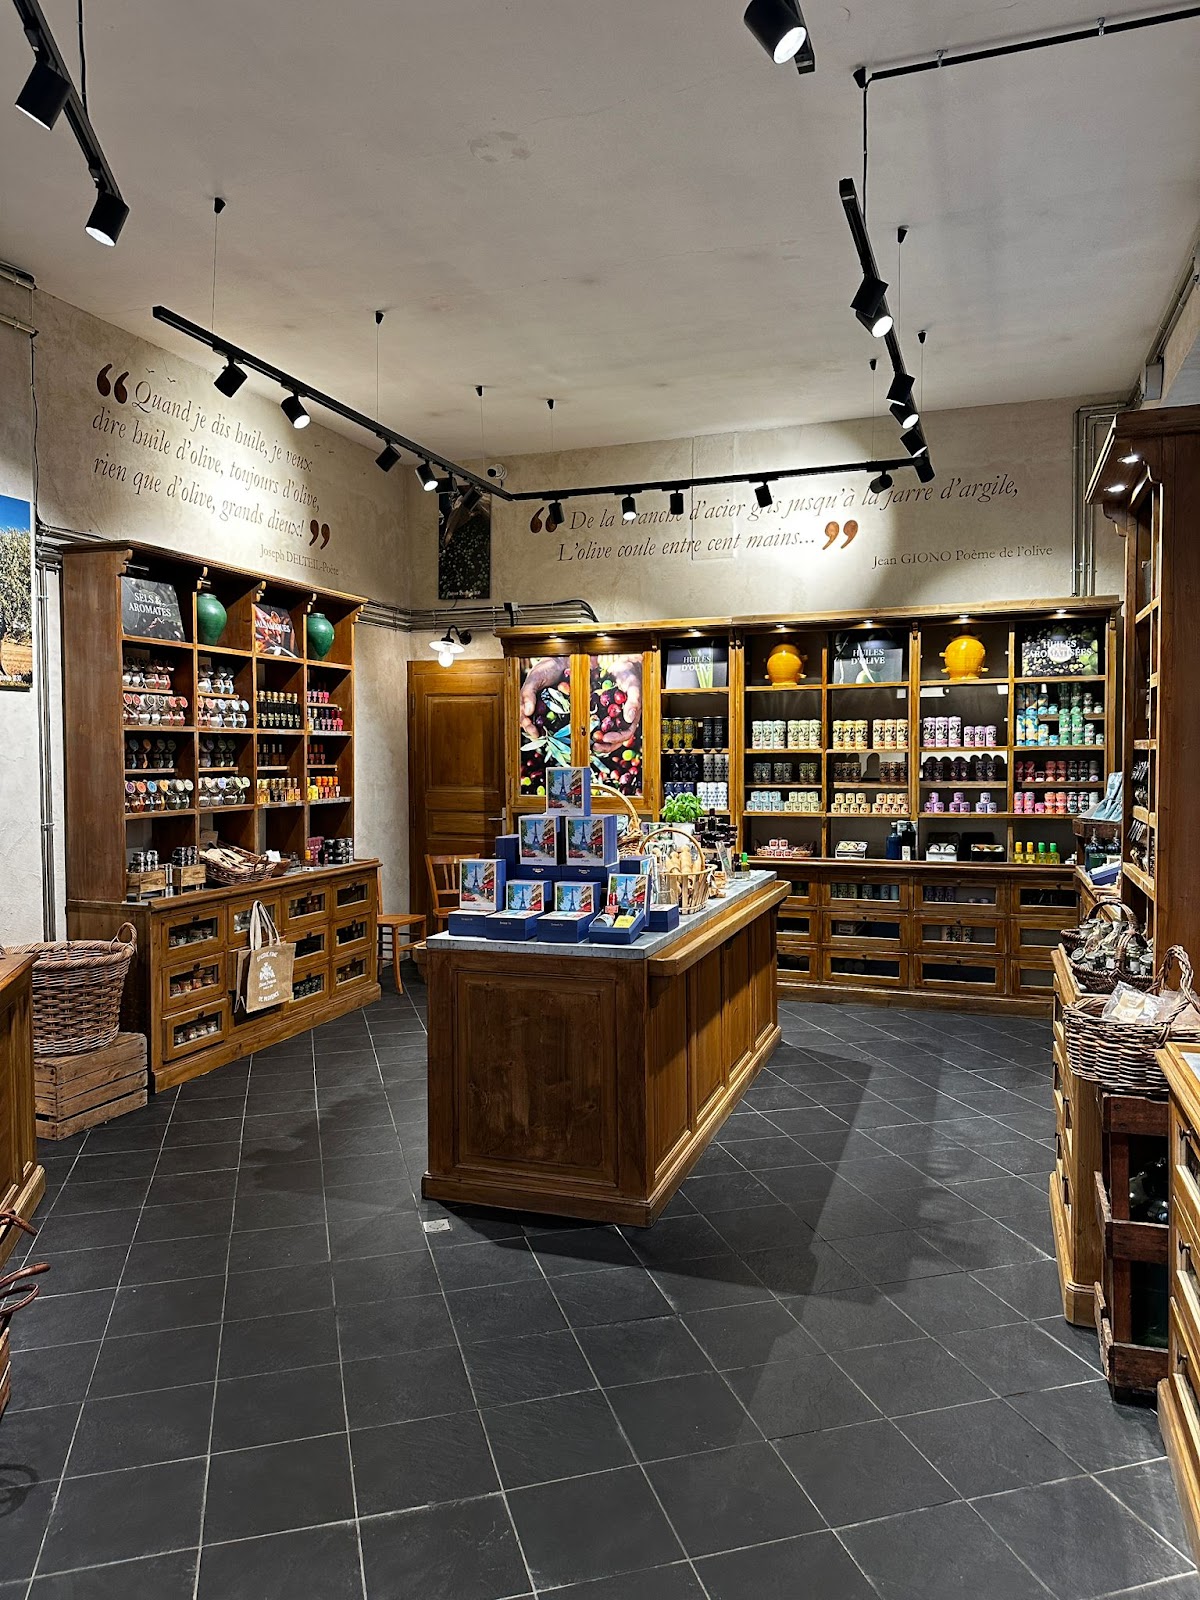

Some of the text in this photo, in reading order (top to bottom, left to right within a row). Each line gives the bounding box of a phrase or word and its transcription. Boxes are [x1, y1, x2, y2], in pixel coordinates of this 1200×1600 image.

[132, 380, 192, 423] Quand
[190, 407, 207, 432] je
[211, 414, 230, 439] dis
[269, 439, 283, 464] je
[286, 451, 313, 472] veux
[92, 406, 126, 439] dire
[176, 438, 224, 476] d'olive,
[230, 461, 279, 494] toujours
[282, 479, 320, 513] d'olive,
[93, 453, 305, 537] rien que d'olive, grands dieux!
[570, 510, 594, 530] De
[600, 508, 615, 527] la
[689, 499, 746, 520] d'acier
[781, 487, 855, 519] jusqu'à
[880, 484, 934, 511] jarre
[940, 473, 1019, 503] d'argile,
[260, 544, 285, 563] Joseph
[557, 541, 612, 562] L'olive
[617, 538, 656, 558] coule
[662, 540, 702, 555] entre
[707, 534, 740, 551] cent
[872, 545, 1053, 569] Jean GIONO Poème de l'olive
[134, 592, 154, 604] SELS
[128, 602, 172, 617] AROMATES
[683, 655, 712, 664] HUILES
[851, 656, 886, 666] D'OLIVE
[853, 648, 885, 657] HUILES
[681, 663, 713, 672] D'OLIVE
